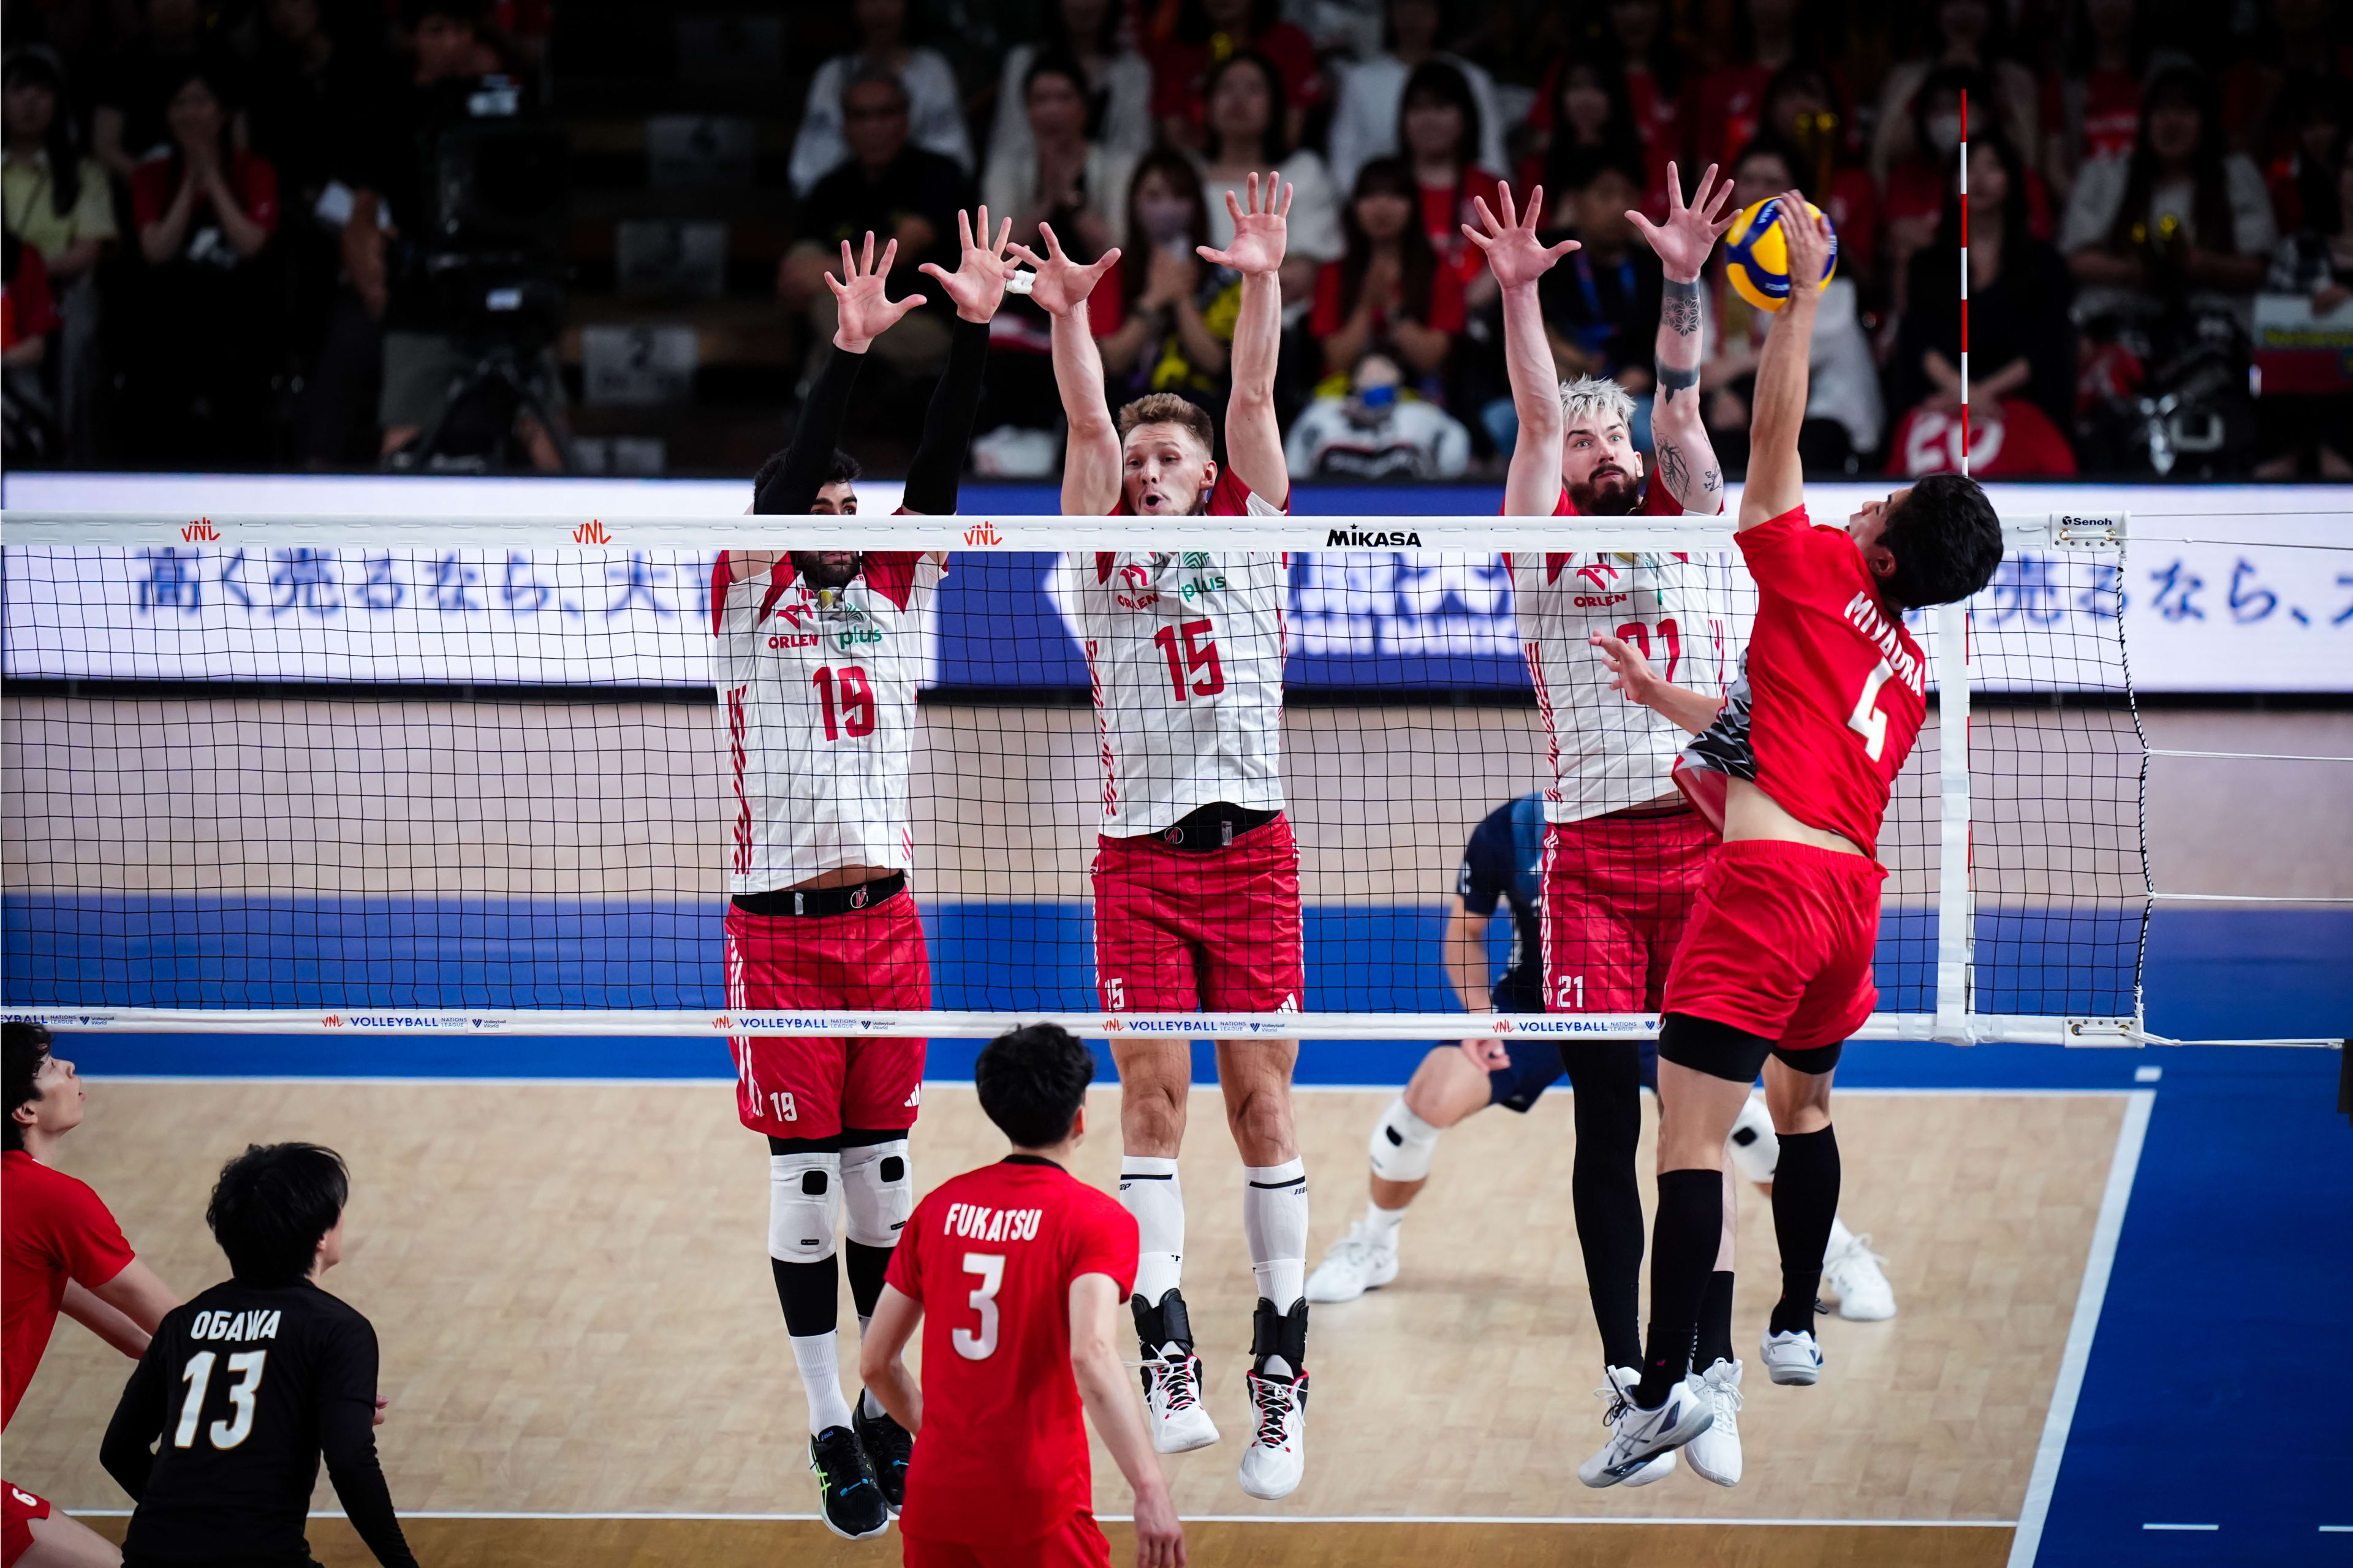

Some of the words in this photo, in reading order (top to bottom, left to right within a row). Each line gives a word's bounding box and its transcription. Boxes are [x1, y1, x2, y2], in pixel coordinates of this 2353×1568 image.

[181, 517, 221, 542] VNL
[573, 520, 612, 544] VNL
[963, 521, 1002, 546] VNL
[1327, 528, 1422, 547] MIKASA
[1181, 576, 1226, 602] plus
[1574, 593, 1627, 608] ORLEN
[1118, 593, 1159, 611] ORLEN
[768, 634, 819, 650] ORLEN
[839, 626, 882, 650] plus
[1844, 590, 1923, 697] MIYAURA
[1154, 619, 1224, 701] 15
[813, 666, 874, 741] 19
[1847, 656, 1893, 763] 4
[1105, 978, 1125, 1011] 15
[1557, 975, 1583, 1008] 21
[321, 1014, 344, 1028] VNL
[350, 1017, 439, 1026] VOLLEYBALL
[712, 1015, 734, 1029] VNL
[740, 1018, 828, 1028] VOLLEYBALL
[1102, 1018, 1124, 1031] VNL
[1129, 1021, 1218, 1031] VOLLEYBALL
[1492, 1019, 1515, 1033] VNL
[1519, 1022, 1608, 1031] VOLLEYBALL
[770, 1093, 797, 1121] 19
[944, 1203, 1042, 1241] FUKATSU
[952, 1252, 1006, 1360] 3
[191, 1309, 281, 1341] OGAWA
[175, 1349, 268, 1450] 13
[12, 1488, 37, 1507] 6
